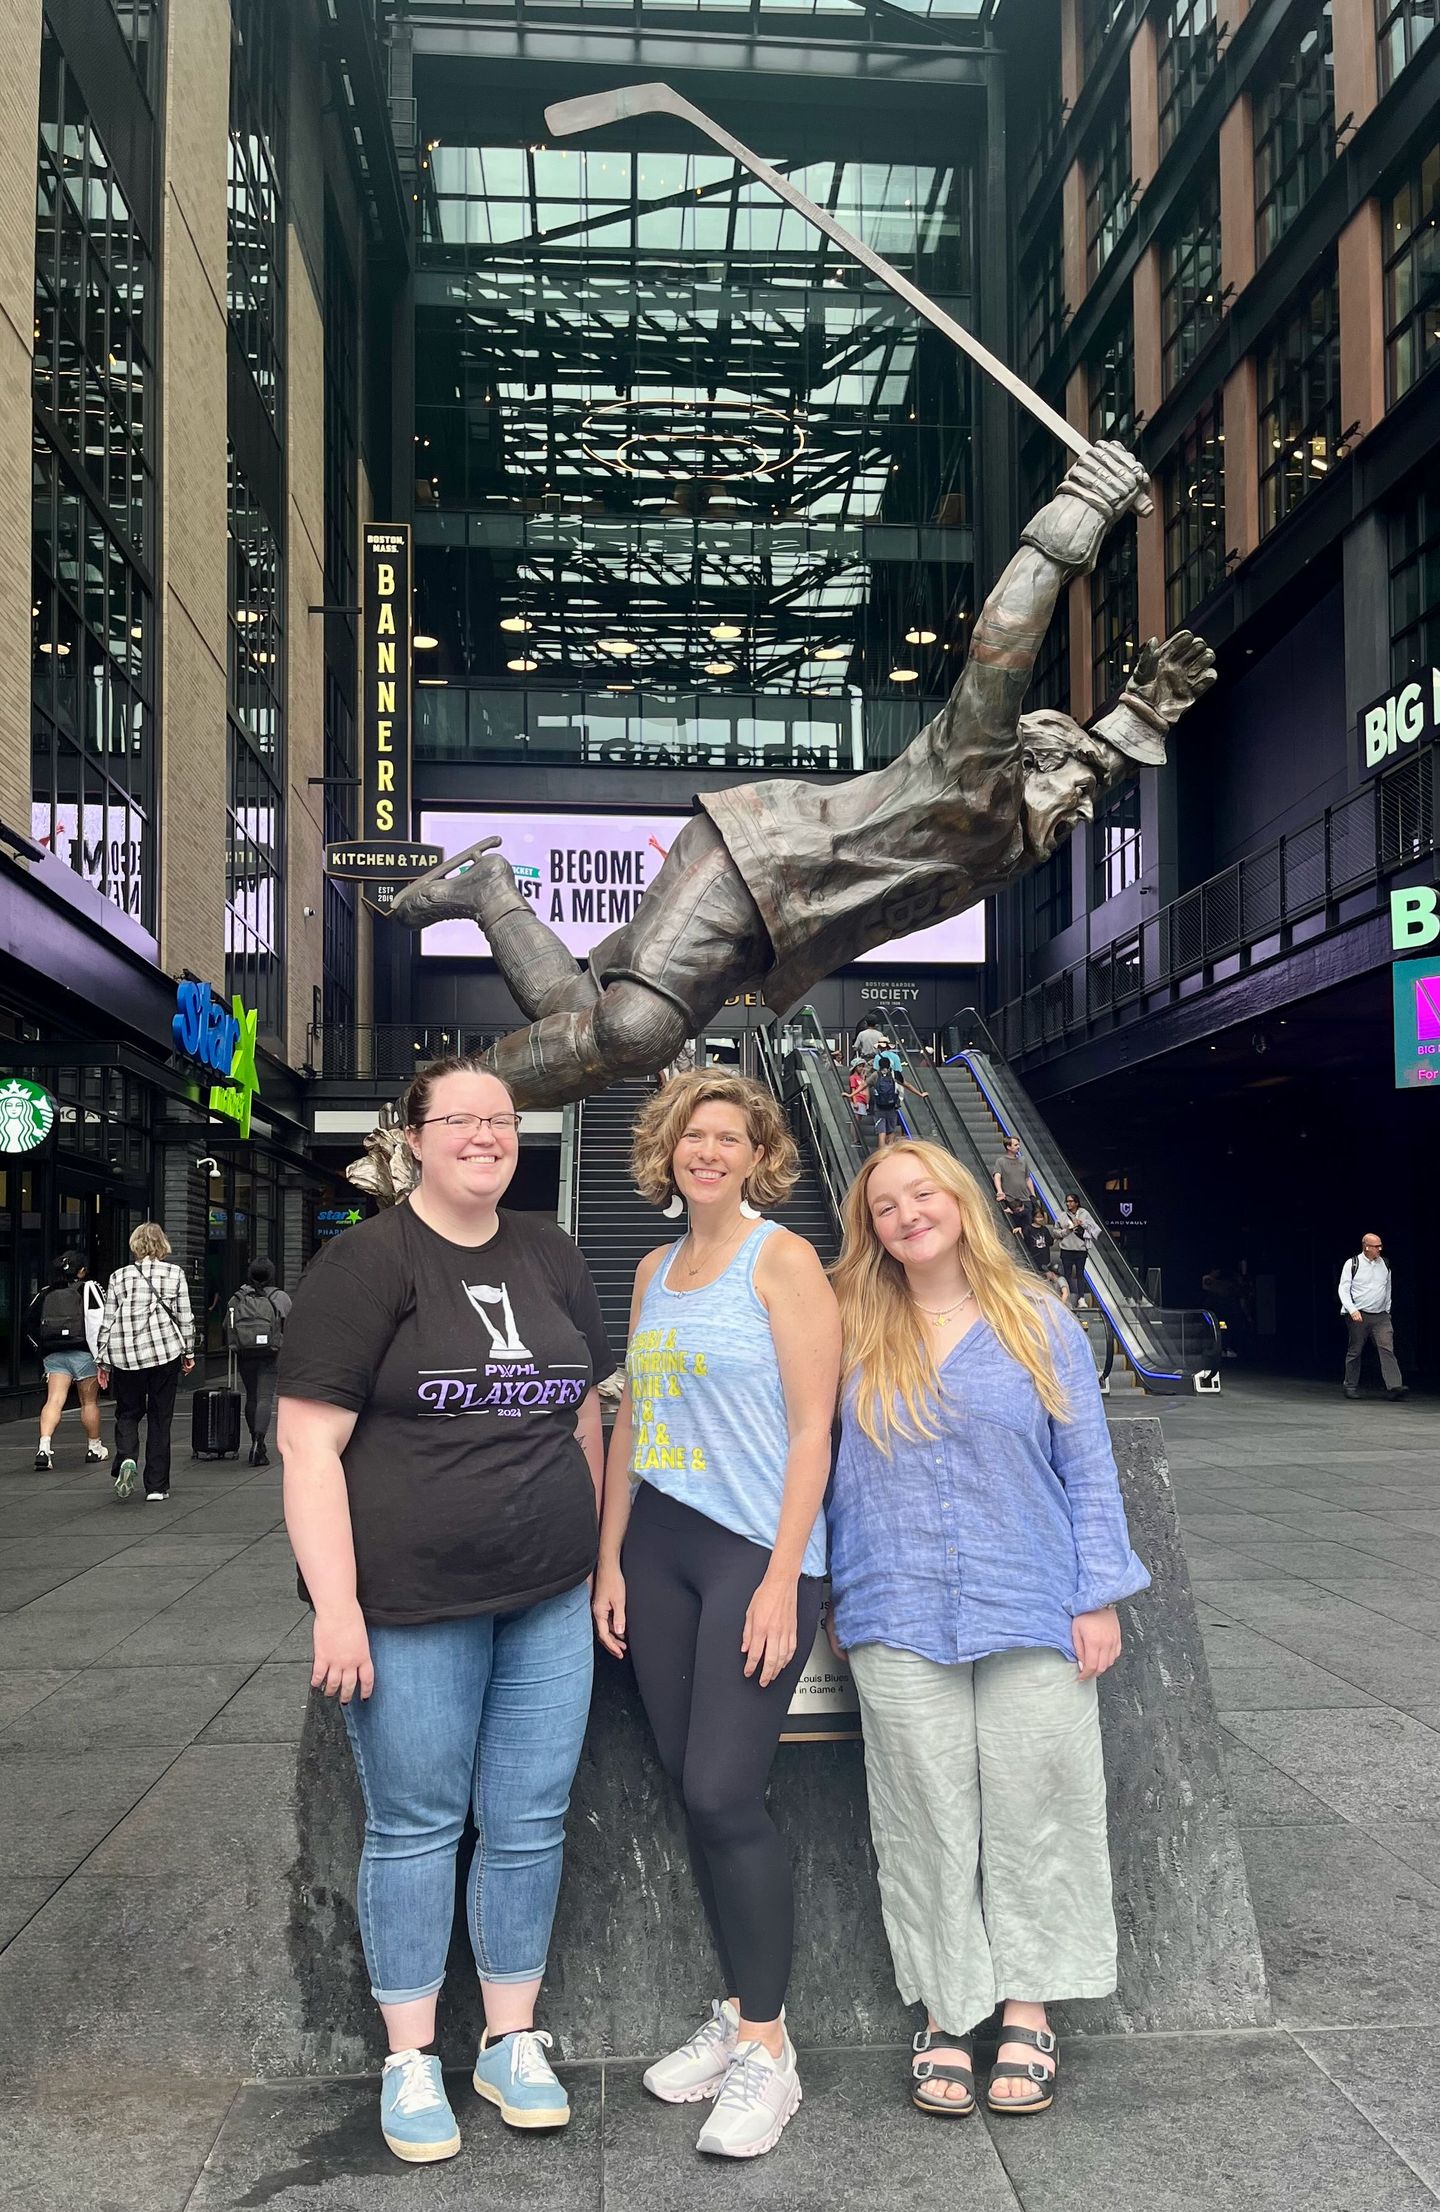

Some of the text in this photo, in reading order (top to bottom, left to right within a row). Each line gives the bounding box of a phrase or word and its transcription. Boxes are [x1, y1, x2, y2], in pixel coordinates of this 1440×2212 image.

[367, 535, 405, 545] BOSTON,
[372, 545, 399, 553] MASS.
[376, 563, 396, 831] BANNERS
[1365, 683, 1424, 768] BIG
[332, 853, 438, 867] KITCHEN & TAP
[550, 849, 645, 884] BECOME
[377, 895, 394, 903] 2019
[550, 888, 564, 922] A
[861, 988, 919, 1000] SOCIETY
[1417, 1044, 1436, 1055] BIG
[485, 1364, 540, 1378] PWHL
[693, 1352, 708, 1376] &
[417, 1379, 586, 1410] PLAYOFFS
[667, 1374, 682, 1397] &
[655, 1423, 670, 1446] &
[691, 1447, 707, 1471] &
[824, 1673, 849, 1682] Blues
[809, 1685, 836, 1694] Game
